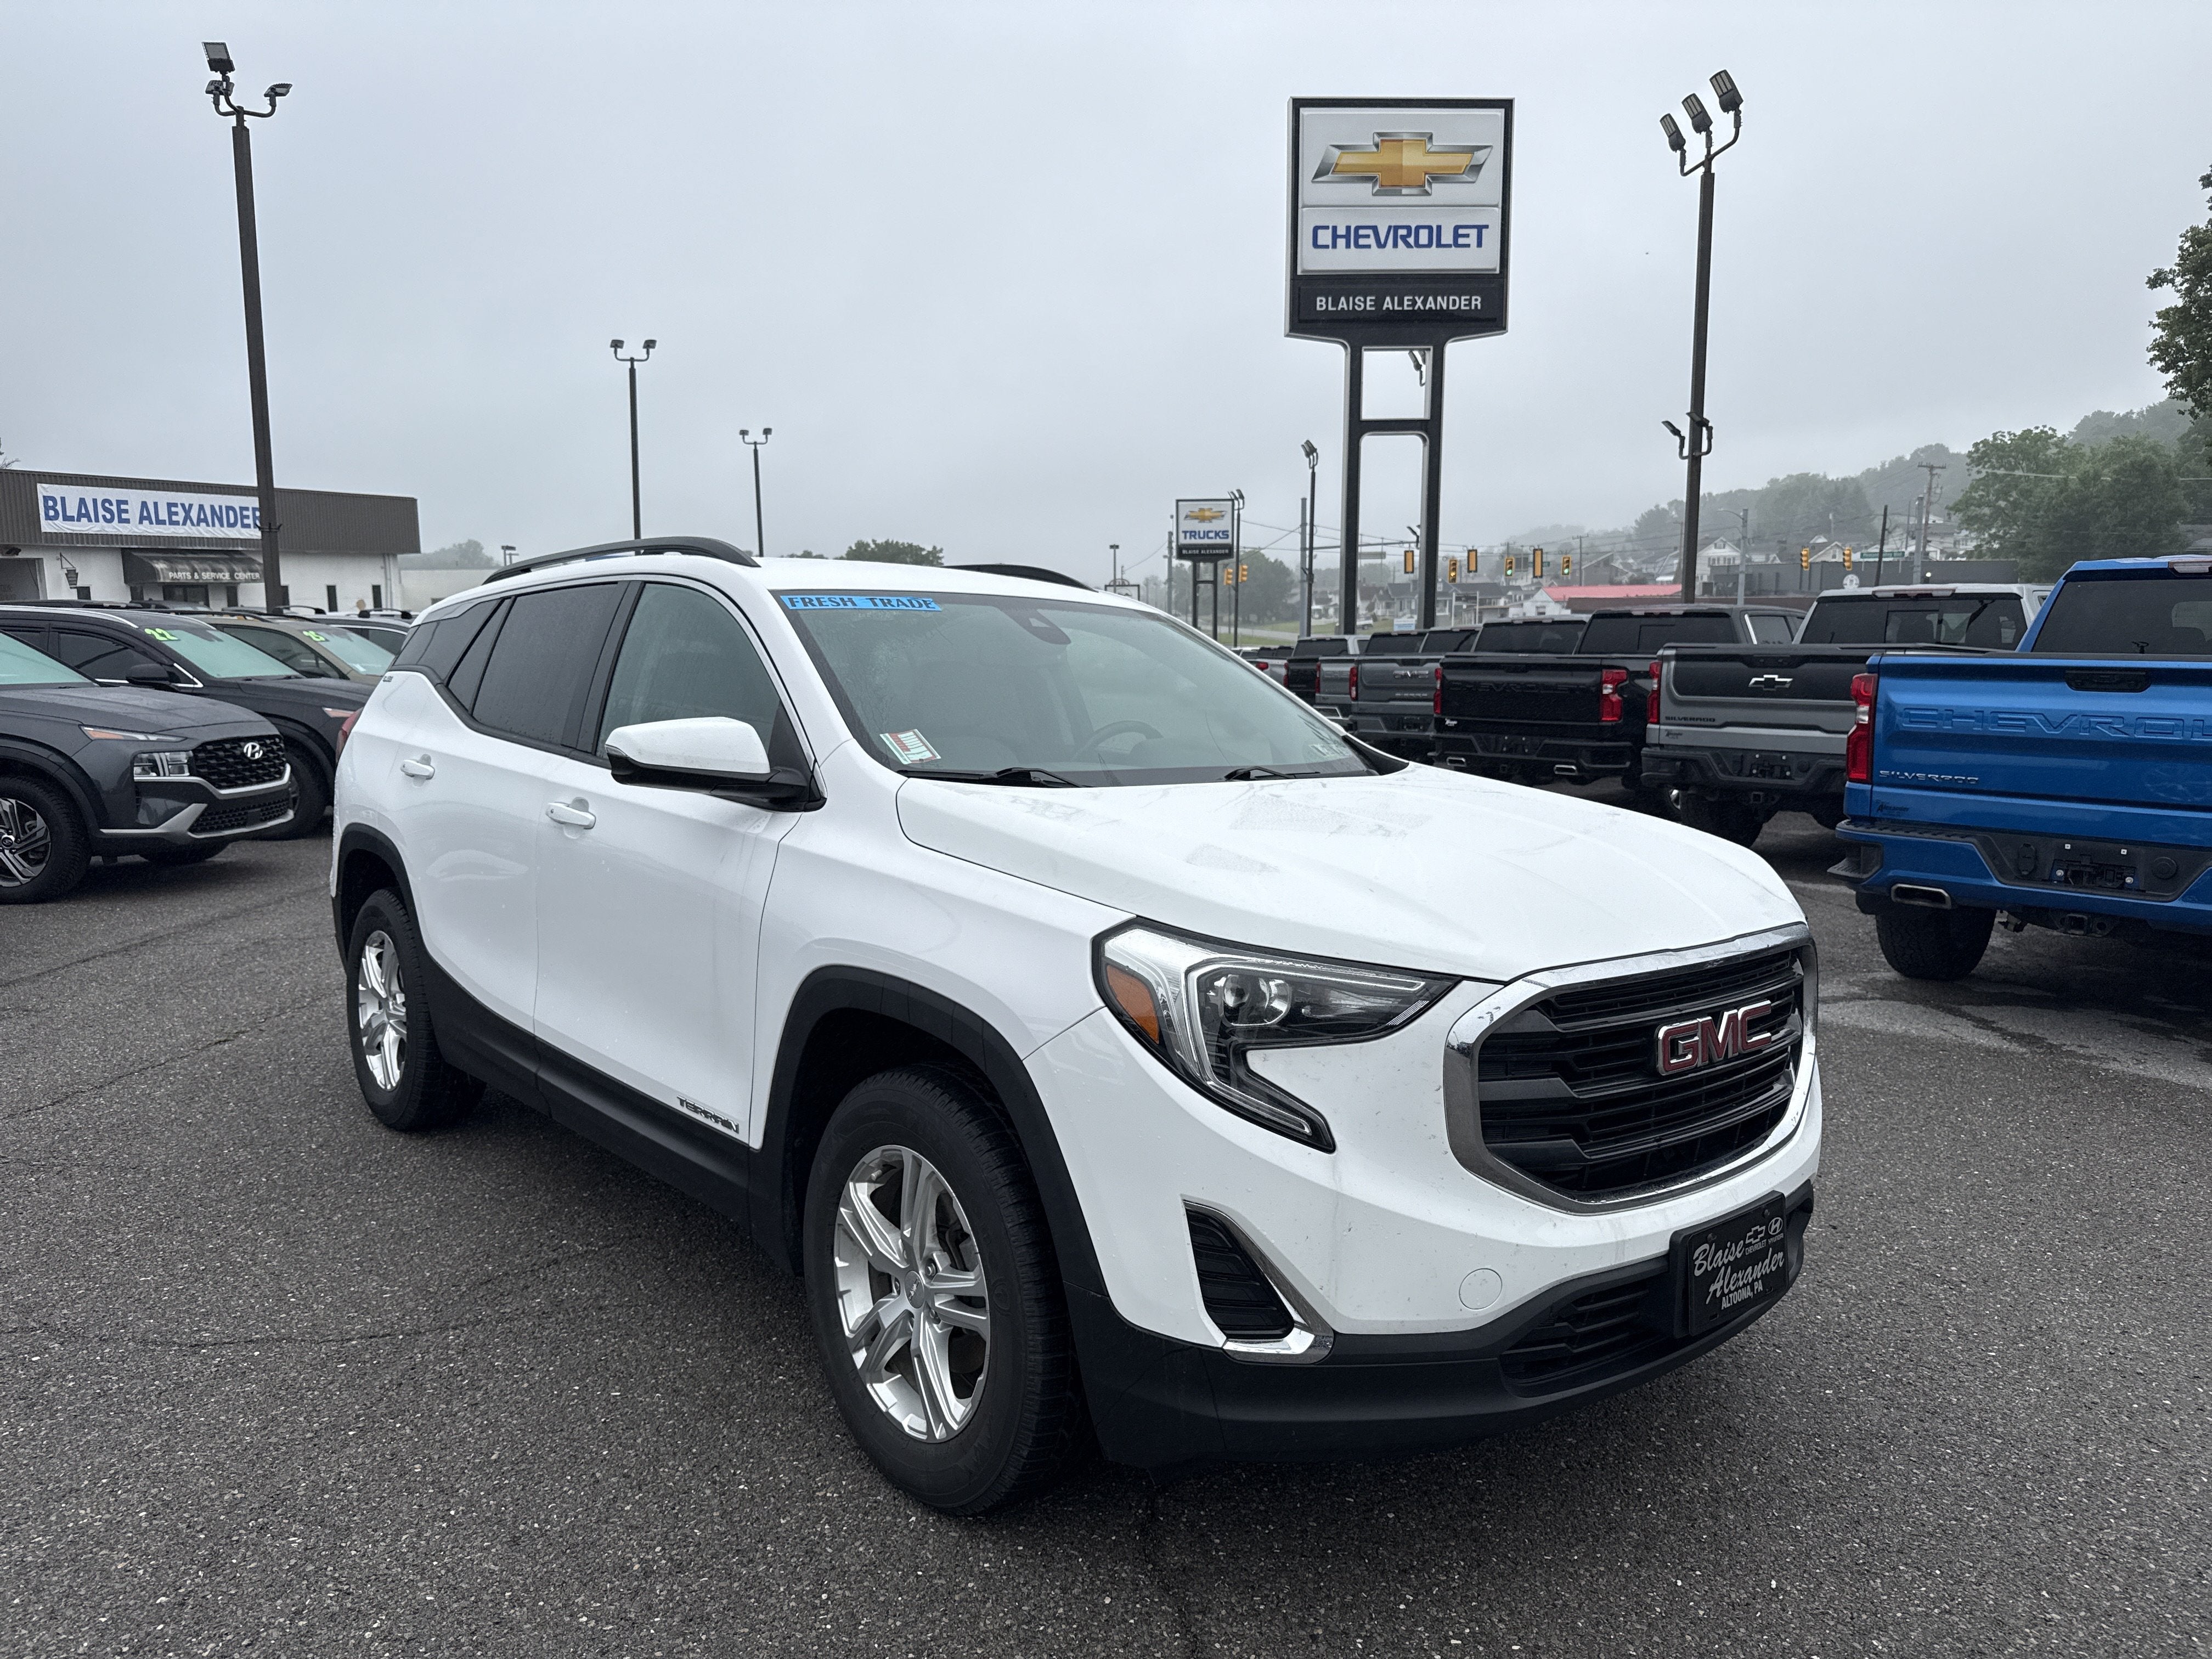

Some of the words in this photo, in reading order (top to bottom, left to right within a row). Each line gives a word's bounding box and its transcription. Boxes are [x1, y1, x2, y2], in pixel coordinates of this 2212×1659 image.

[1312, 225, 1489, 249] CHEVROLET
[1316, 296, 1375, 311] BLAISE
[1383, 296, 1481, 311] ALEXANDER
[42, 495, 130, 524] BLAISE
[1182, 529, 1229, 540] TRUCKS
[168, 572, 192, 580] PARTS
[194, 572, 199, 580] &
[201, 572, 230, 580] SERVICE
[788, 597, 858, 607] FRESH
[865, 597, 936, 609] TRADE
[1879, 770, 1979, 784] SILVERADO
[1656, 999, 1772, 1076] GMC
[677, 1094, 740, 1134] TERRAIN
[1693, 1240, 1744, 1277] Blaise
[1745, 1239, 1767, 1255] CHEVROLET
[1706, 1247, 1784, 1305] Alexander
[1721, 1285, 1753, 1310] ALTOONA,
[1754, 1279, 1763, 1294] PA
